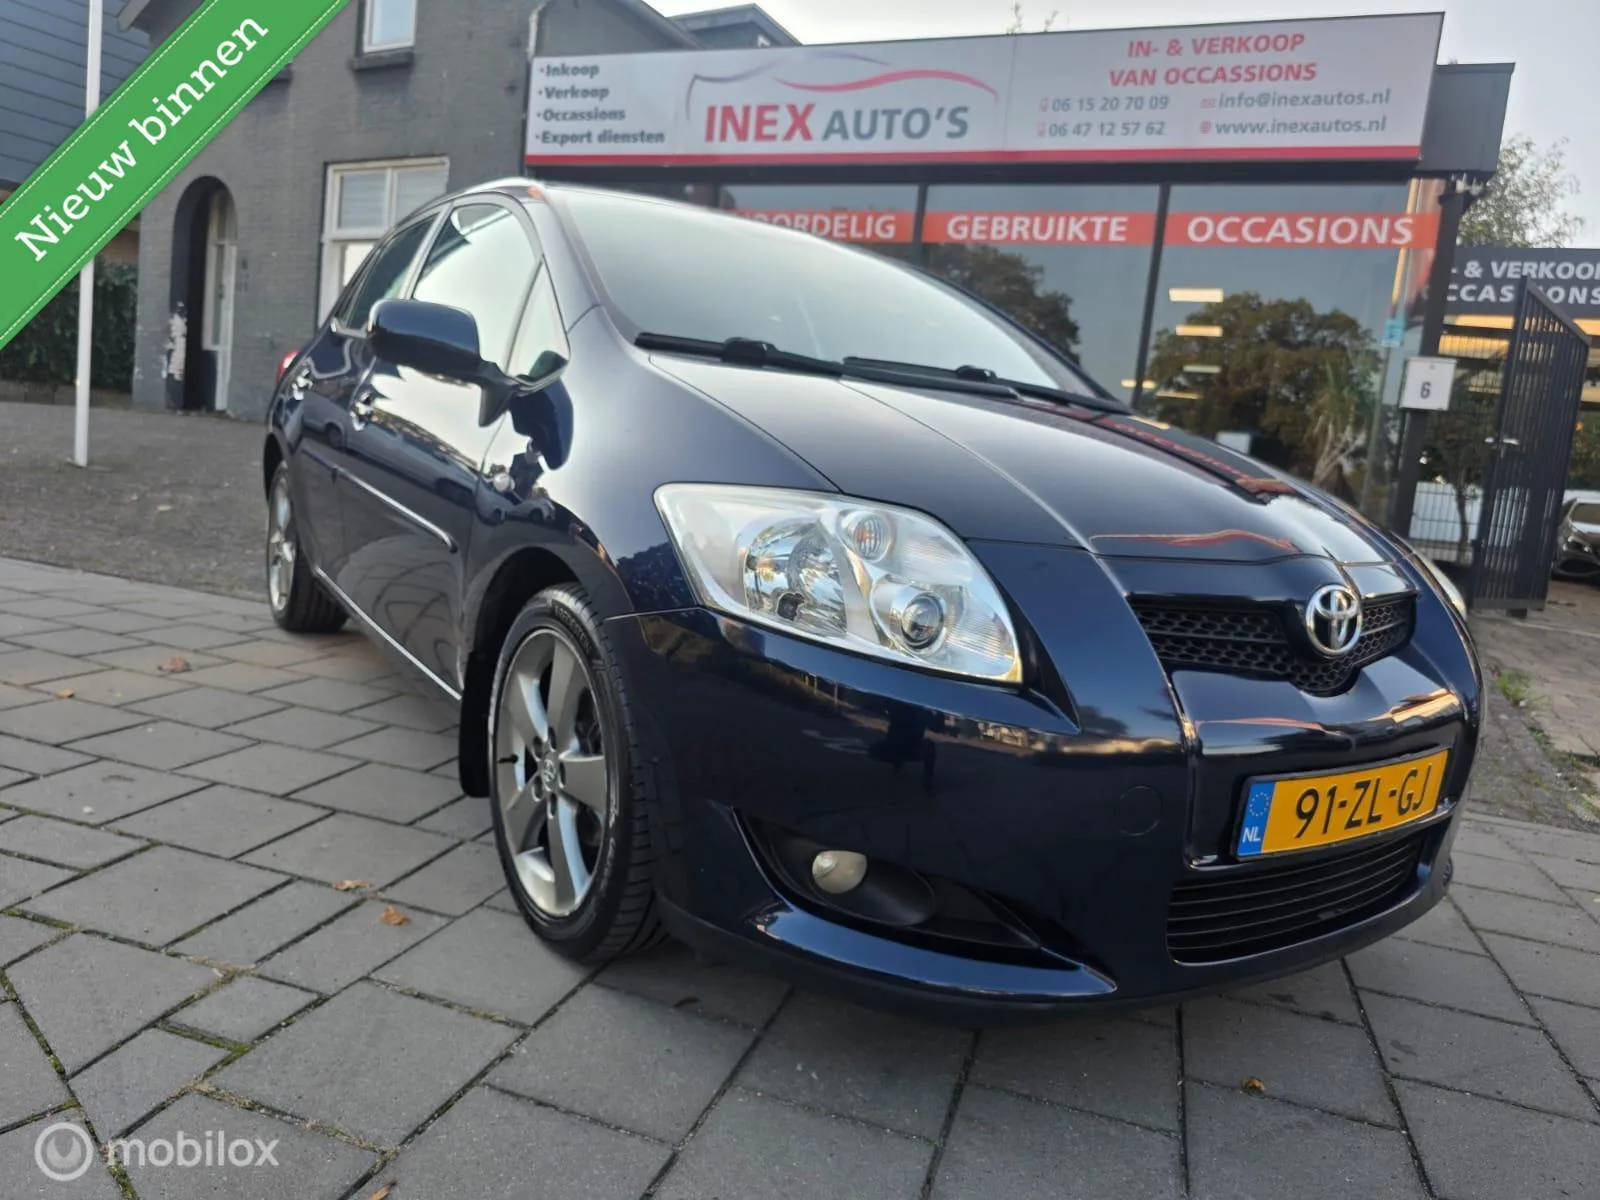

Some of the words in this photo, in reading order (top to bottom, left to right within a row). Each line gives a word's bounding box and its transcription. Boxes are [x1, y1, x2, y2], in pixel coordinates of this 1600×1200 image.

[1127, 40, 1159, 58] IN-
[1166, 38, 1184, 56] &
[1192, 33, 1305, 55] VERKOOP
[545, 63, 600, 79] Inkoop
[1109, 69, 1157, 87] VAN
[1164, 63, 1317, 85] OCCASSIONS
[544, 84, 610, 101] Verkoop
[1218, 87, 1391, 109] info@inexautos.nl
[1051, 98, 1071, 112] 06
[1078, 98, 1095, 111] 15
[1100, 97, 1120, 111] 20
[1125, 96, 1144, 110] 70
[1149, 95, 1169, 110] 09
[704, 103, 816, 143] INEX
[821, 106, 970, 141] AUTO'S
[1049, 122, 1068, 137] 06
[1072, 122, 1092, 137] 47
[1100, 122, 1116, 136] 12
[1121, 122, 1141, 136] 57
[1145, 121, 1166, 136] 62
[1215, 115, 1387, 135] www.inexautos.nl
[541, 130, 592, 147] Export
[597, 129, 665, 144] diensten
[744, 212, 897, 239] ORDELIG
[947, 215, 1129, 242] GEBRUIKTE
[1187, 216, 1413, 245] OCCASIONS
[1464, 260, 1483, 279] &
[1420, 381, 1432, 399] 6
[1295, 765, 1432, 839] 91-ZL-GJ
[1241, 826, 1261, 843] NL
